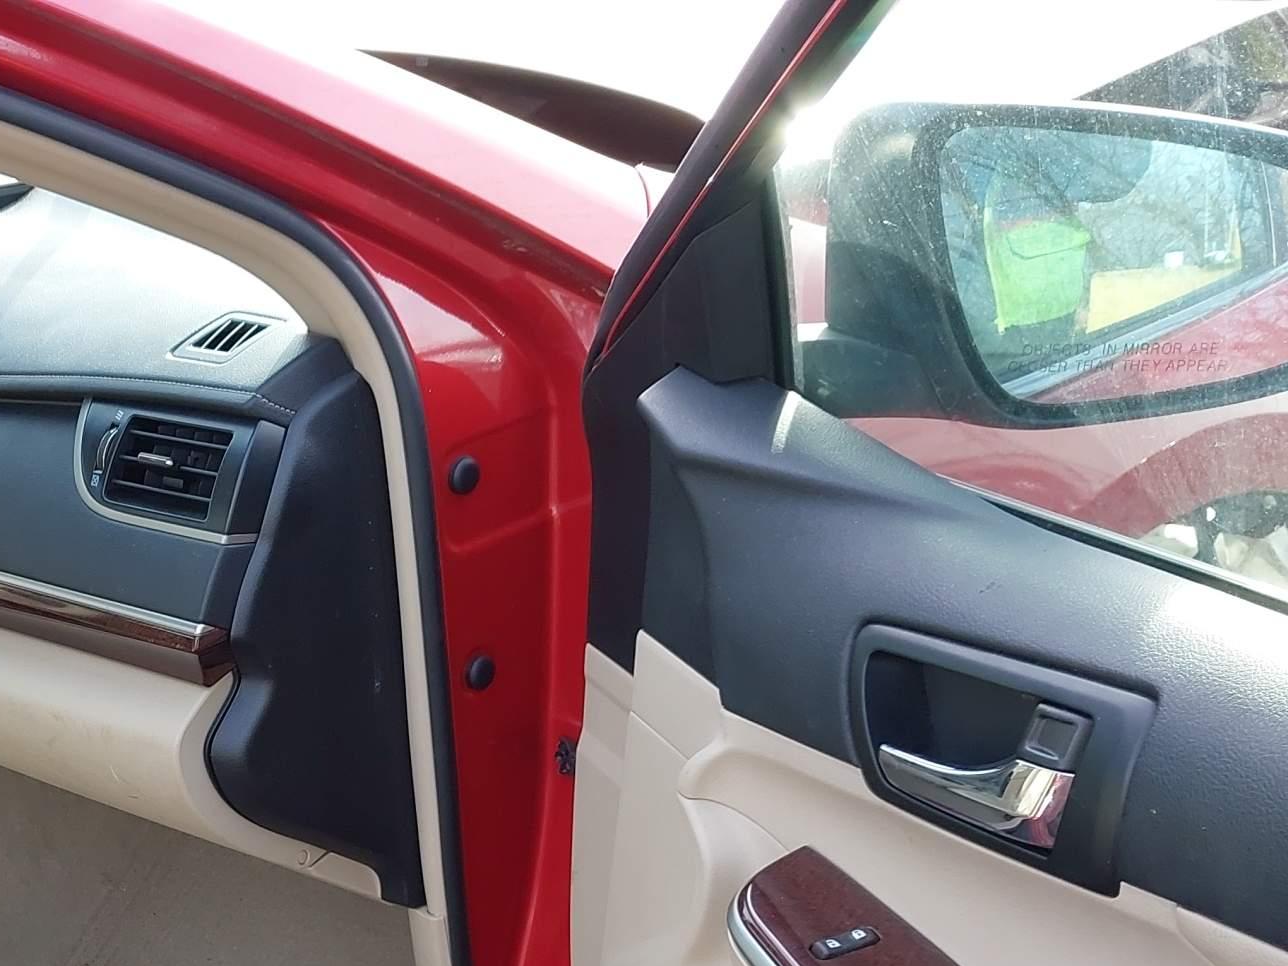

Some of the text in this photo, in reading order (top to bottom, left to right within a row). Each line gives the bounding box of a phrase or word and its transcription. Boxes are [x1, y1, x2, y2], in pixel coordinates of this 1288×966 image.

[1024, 341, 1220, 356] OBJECTS IN MIRROR ARE
[1122, 359, 1164, 373] THEY
[1165, 359, 1228, 373] APPEAR
